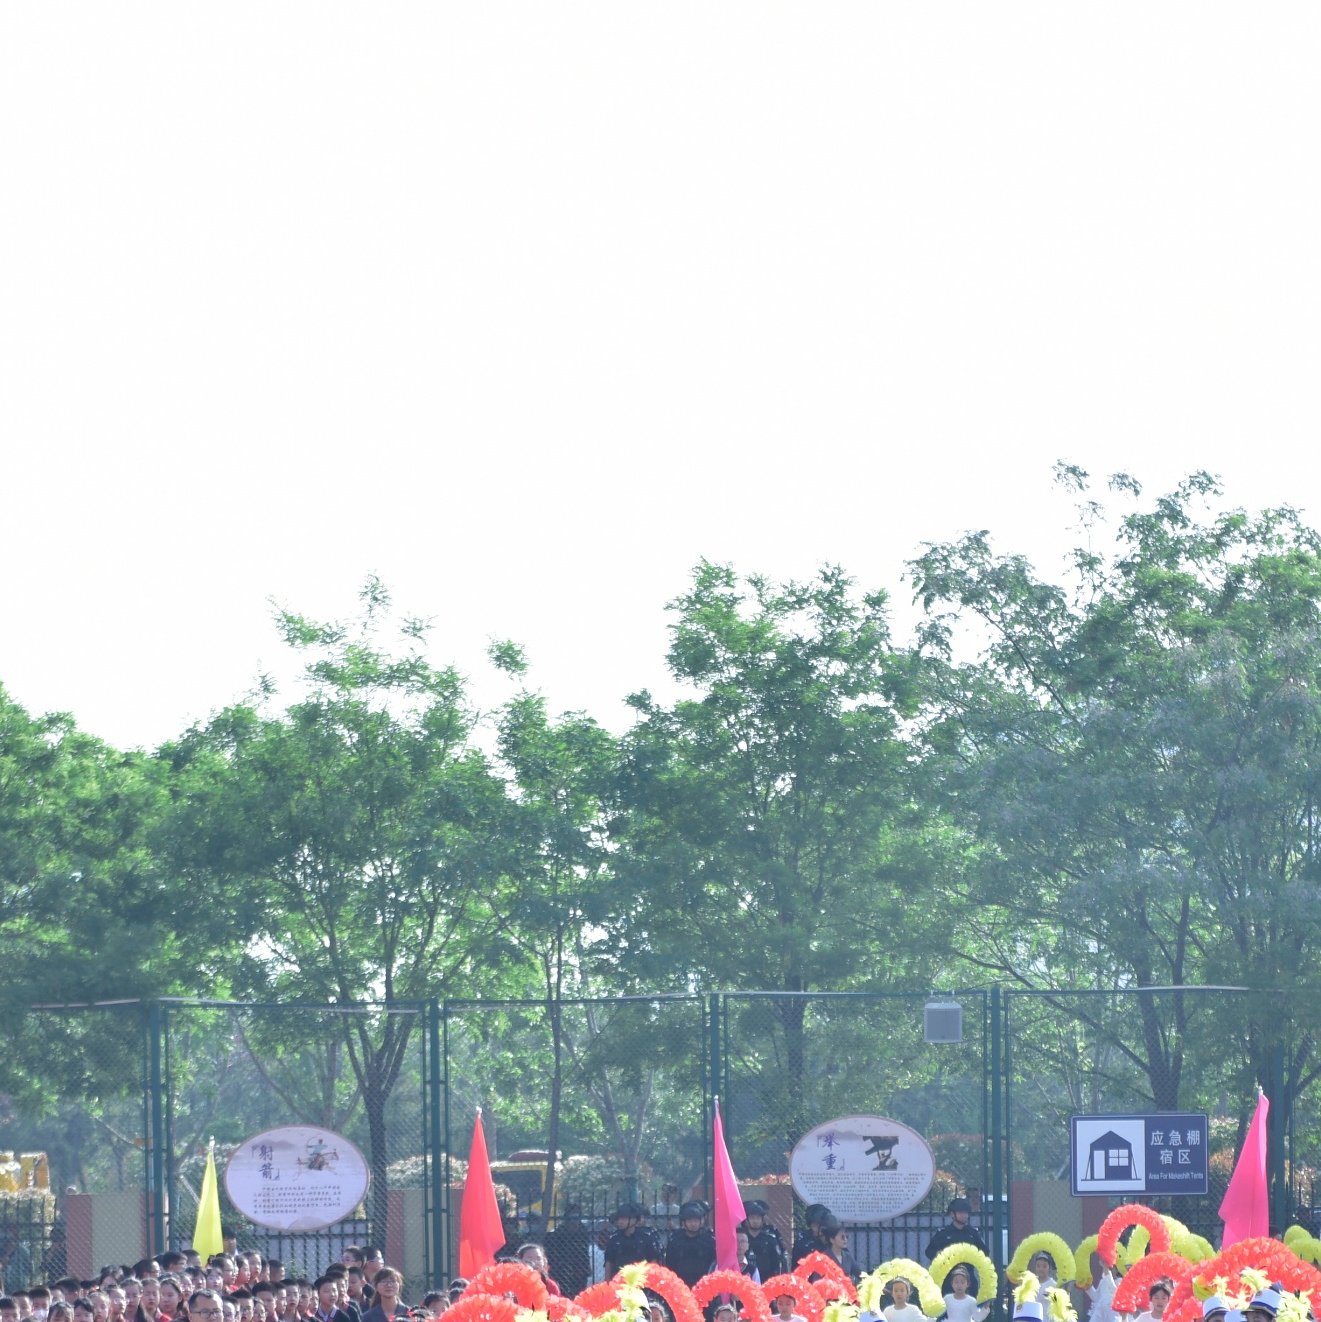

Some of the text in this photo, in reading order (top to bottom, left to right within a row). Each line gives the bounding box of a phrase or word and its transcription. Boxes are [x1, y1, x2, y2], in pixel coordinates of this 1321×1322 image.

[1150, 1129, 1201, 1147] 应急棚
[1160, 1149, 1192, 1165] 宿区
[1160, 1172, 1168, 1180] For
